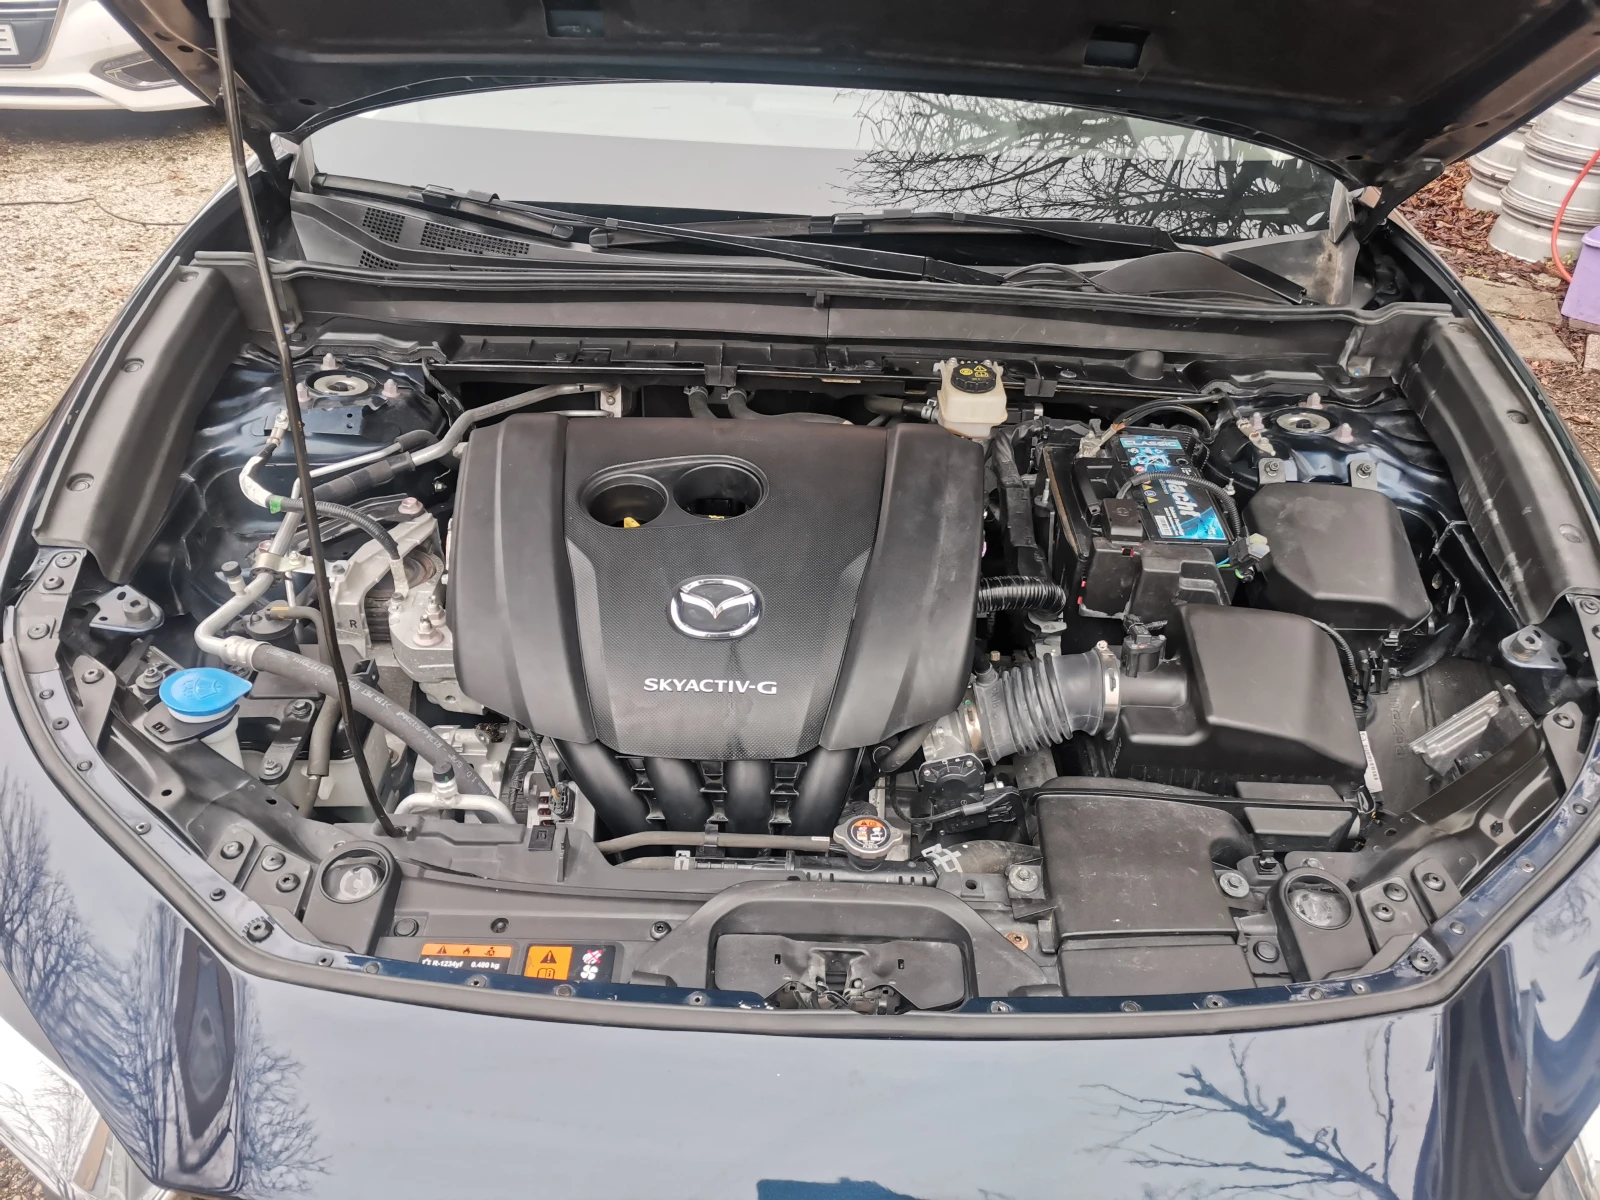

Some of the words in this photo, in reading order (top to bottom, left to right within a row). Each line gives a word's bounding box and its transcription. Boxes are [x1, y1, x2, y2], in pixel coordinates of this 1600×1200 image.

[349, 619, 358, 629] R
[643, 677, 778, 695] SKYACTIV-G
[432, 960, 464, 969] R-1234yf
[490, 961, 500, 970] kg
